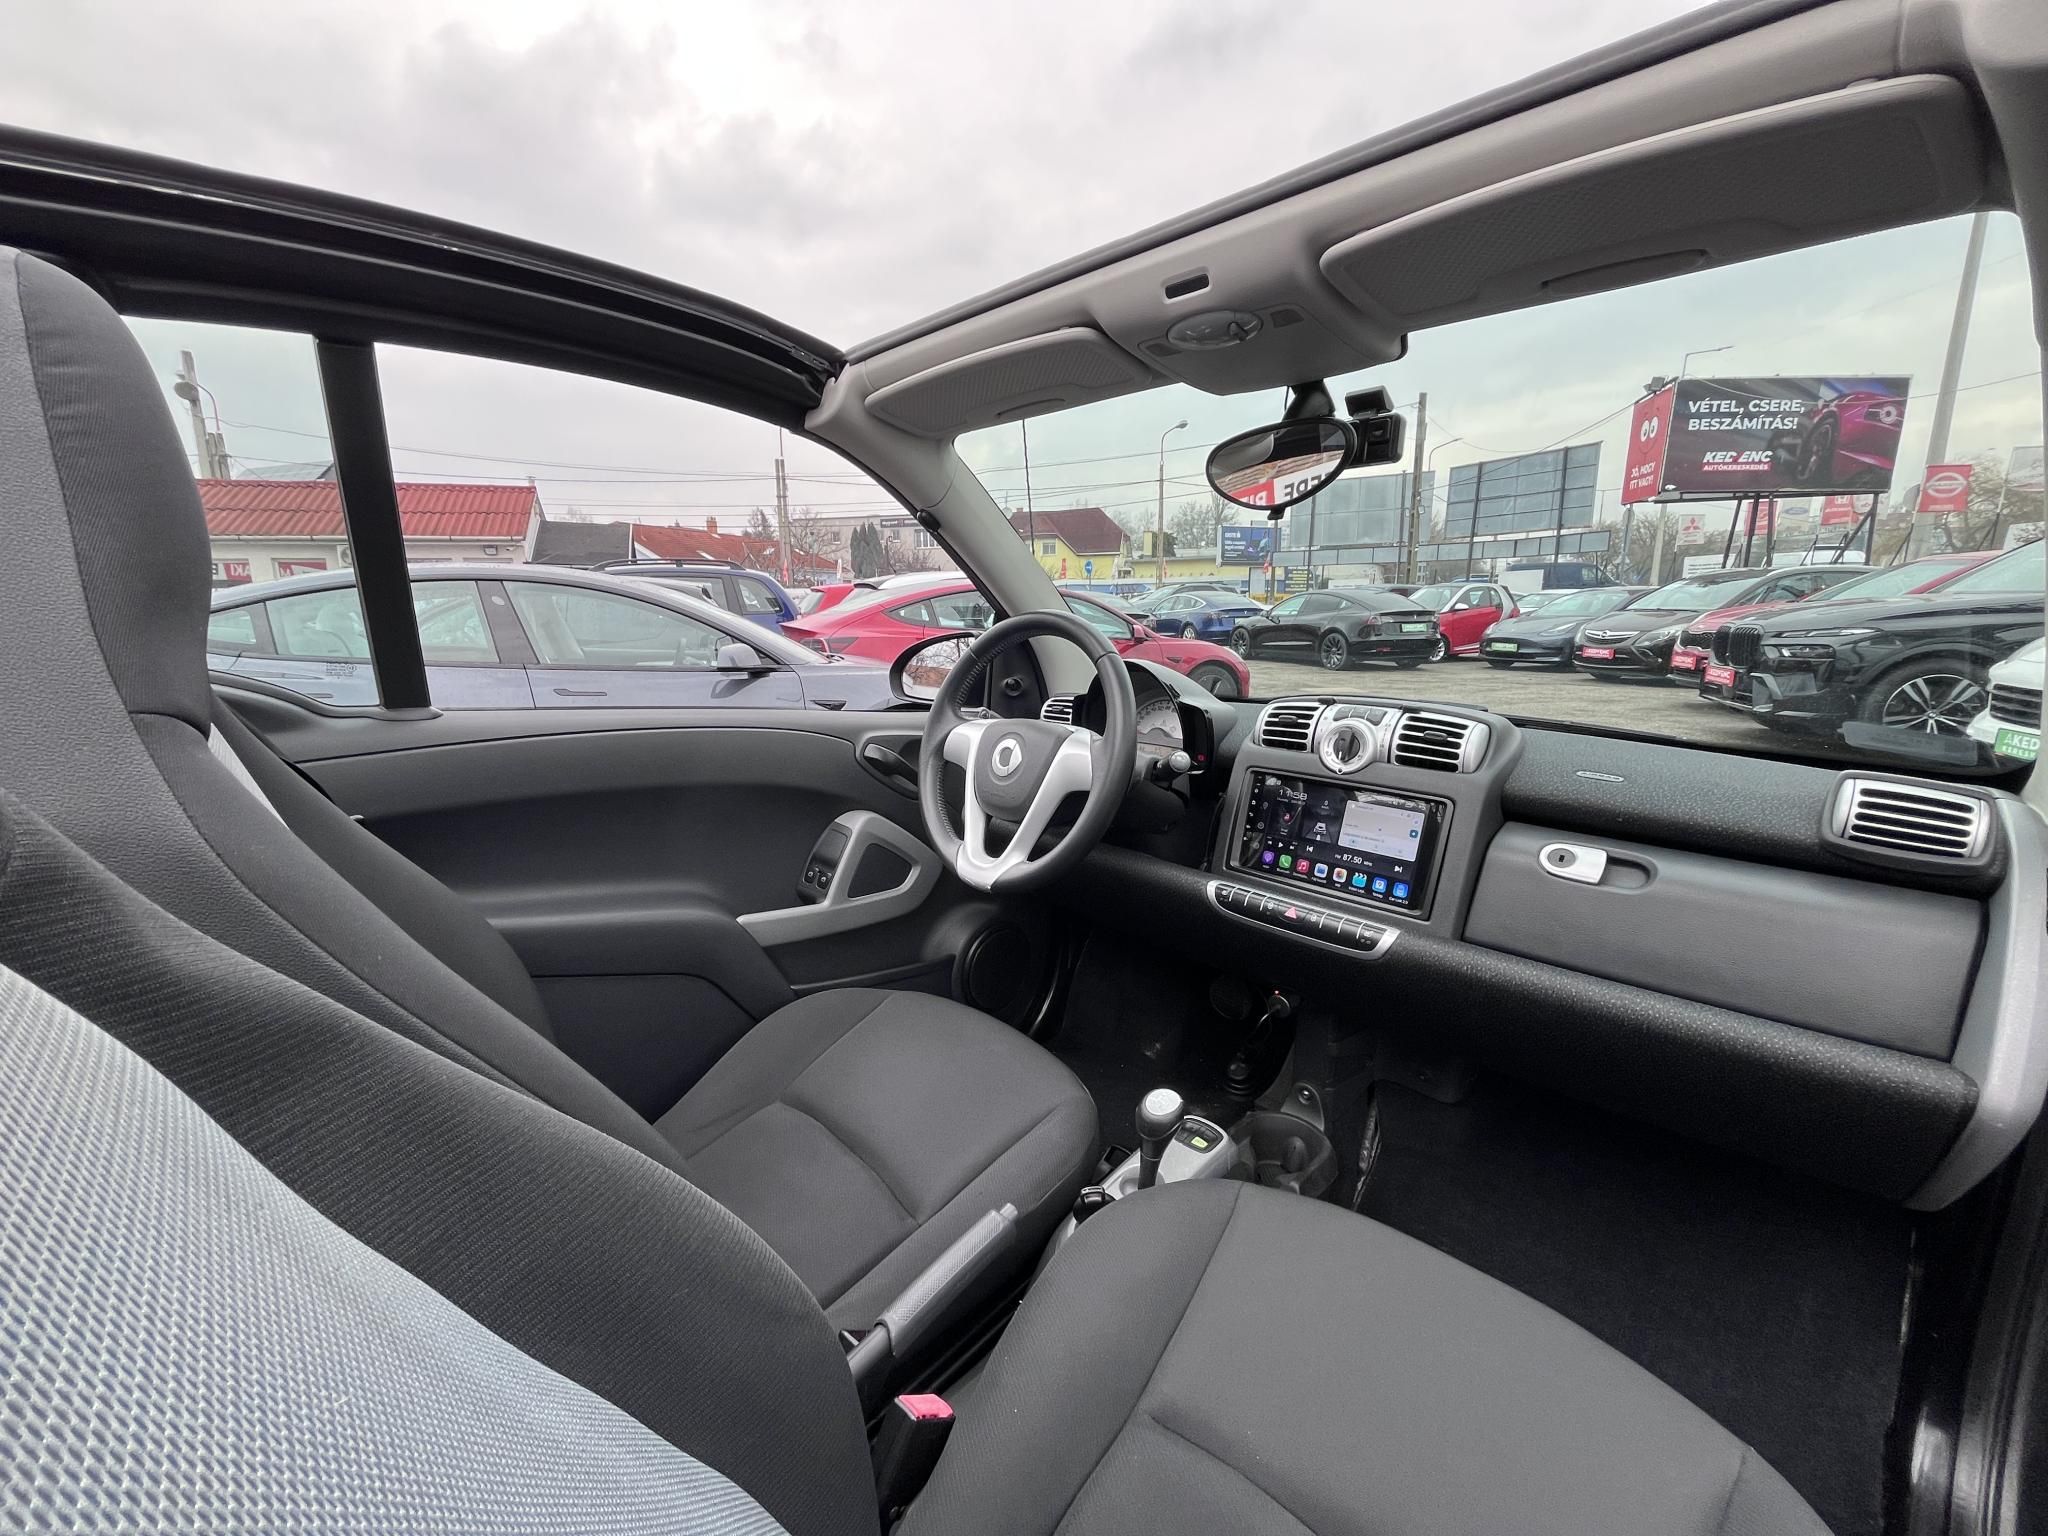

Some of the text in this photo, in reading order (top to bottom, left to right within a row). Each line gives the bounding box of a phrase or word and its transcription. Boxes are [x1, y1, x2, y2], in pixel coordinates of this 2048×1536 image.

[1688, 398, 1806, 414] VÉTEL, CSERE,
[1688, 414, 1798, 431] BESZÁMÍTÁS!
[1342, 853, 1363, 865] 87.50
